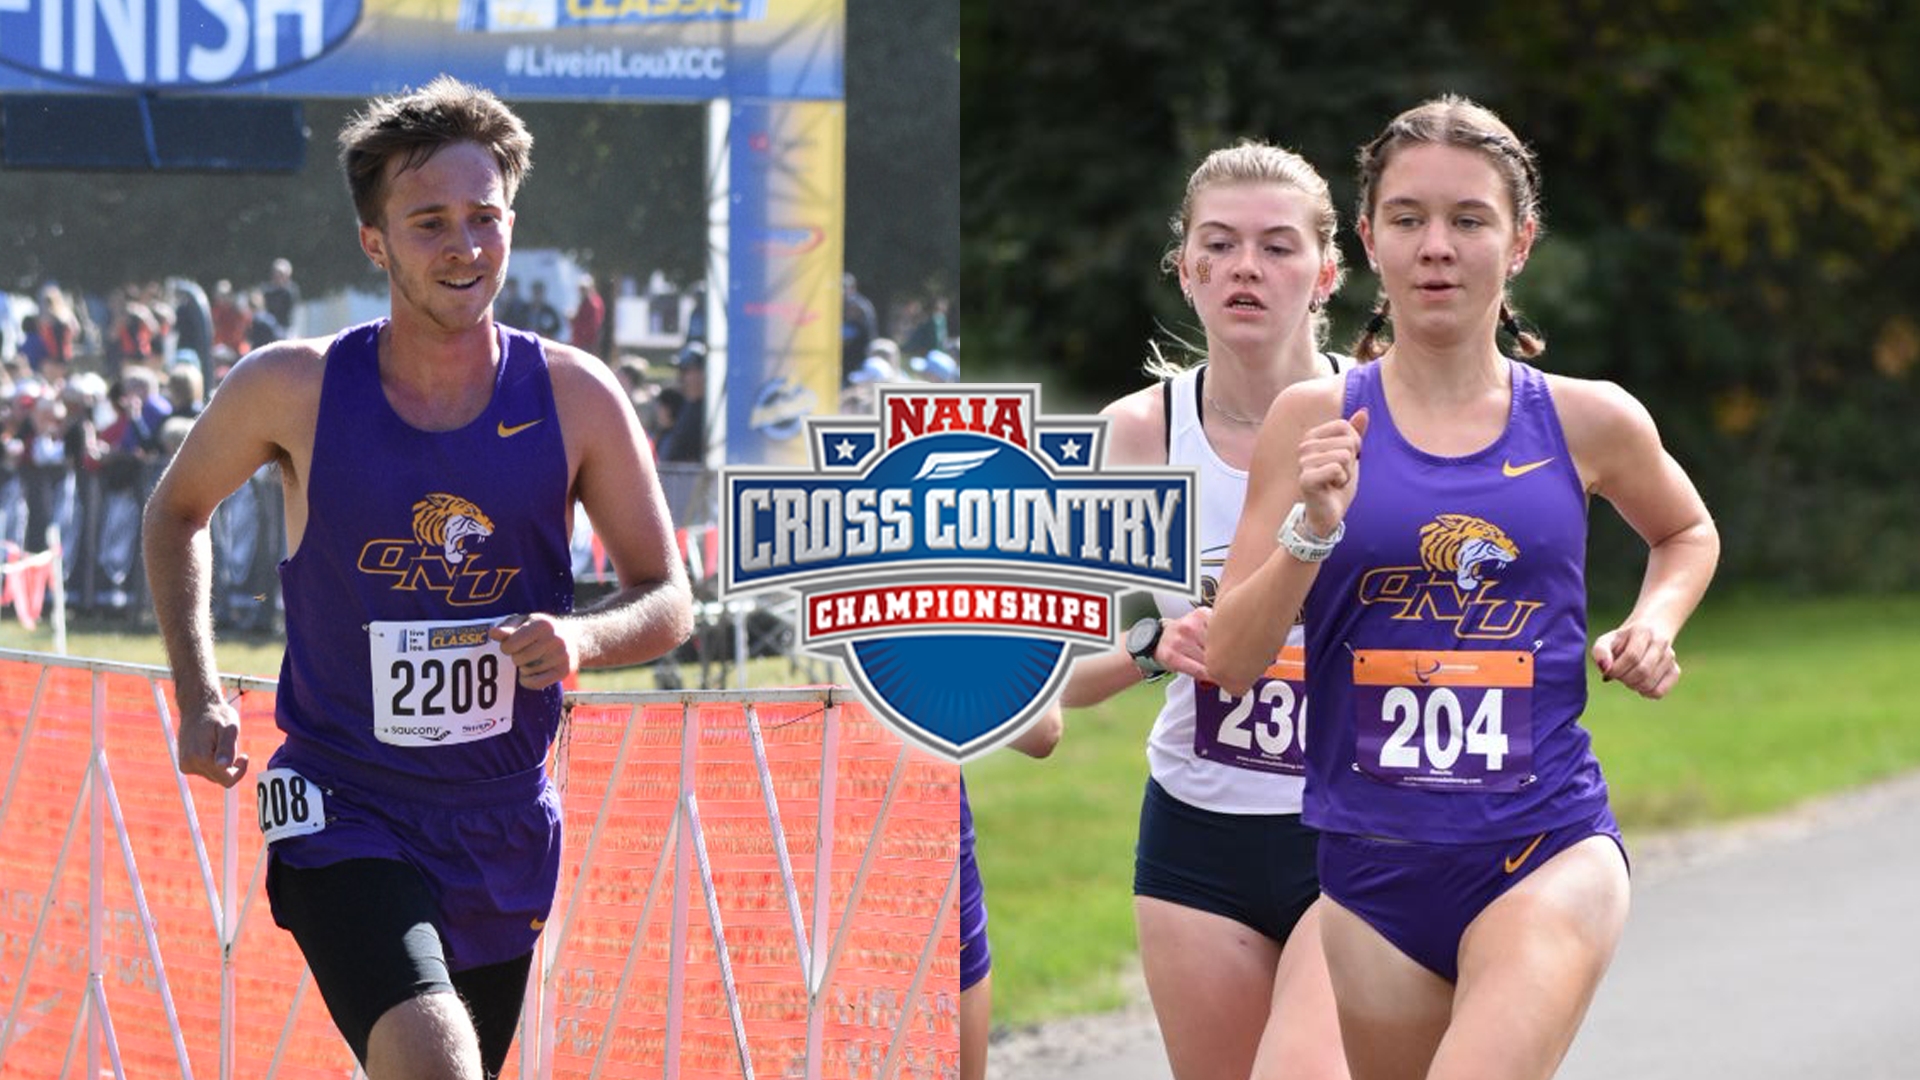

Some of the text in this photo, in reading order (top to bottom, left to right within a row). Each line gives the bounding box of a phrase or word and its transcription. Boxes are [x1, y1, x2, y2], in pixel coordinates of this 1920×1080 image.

[0, 0, 323, 83] INISH
[505, 45, 725, 78] #LiveinLouXCC
[431, 631, 487, 648] CLASSIC
[390, 654, 498, 716] 2208
[390, 725, 441, 736] saucony
[1379, 686, 1509, 770] 204
